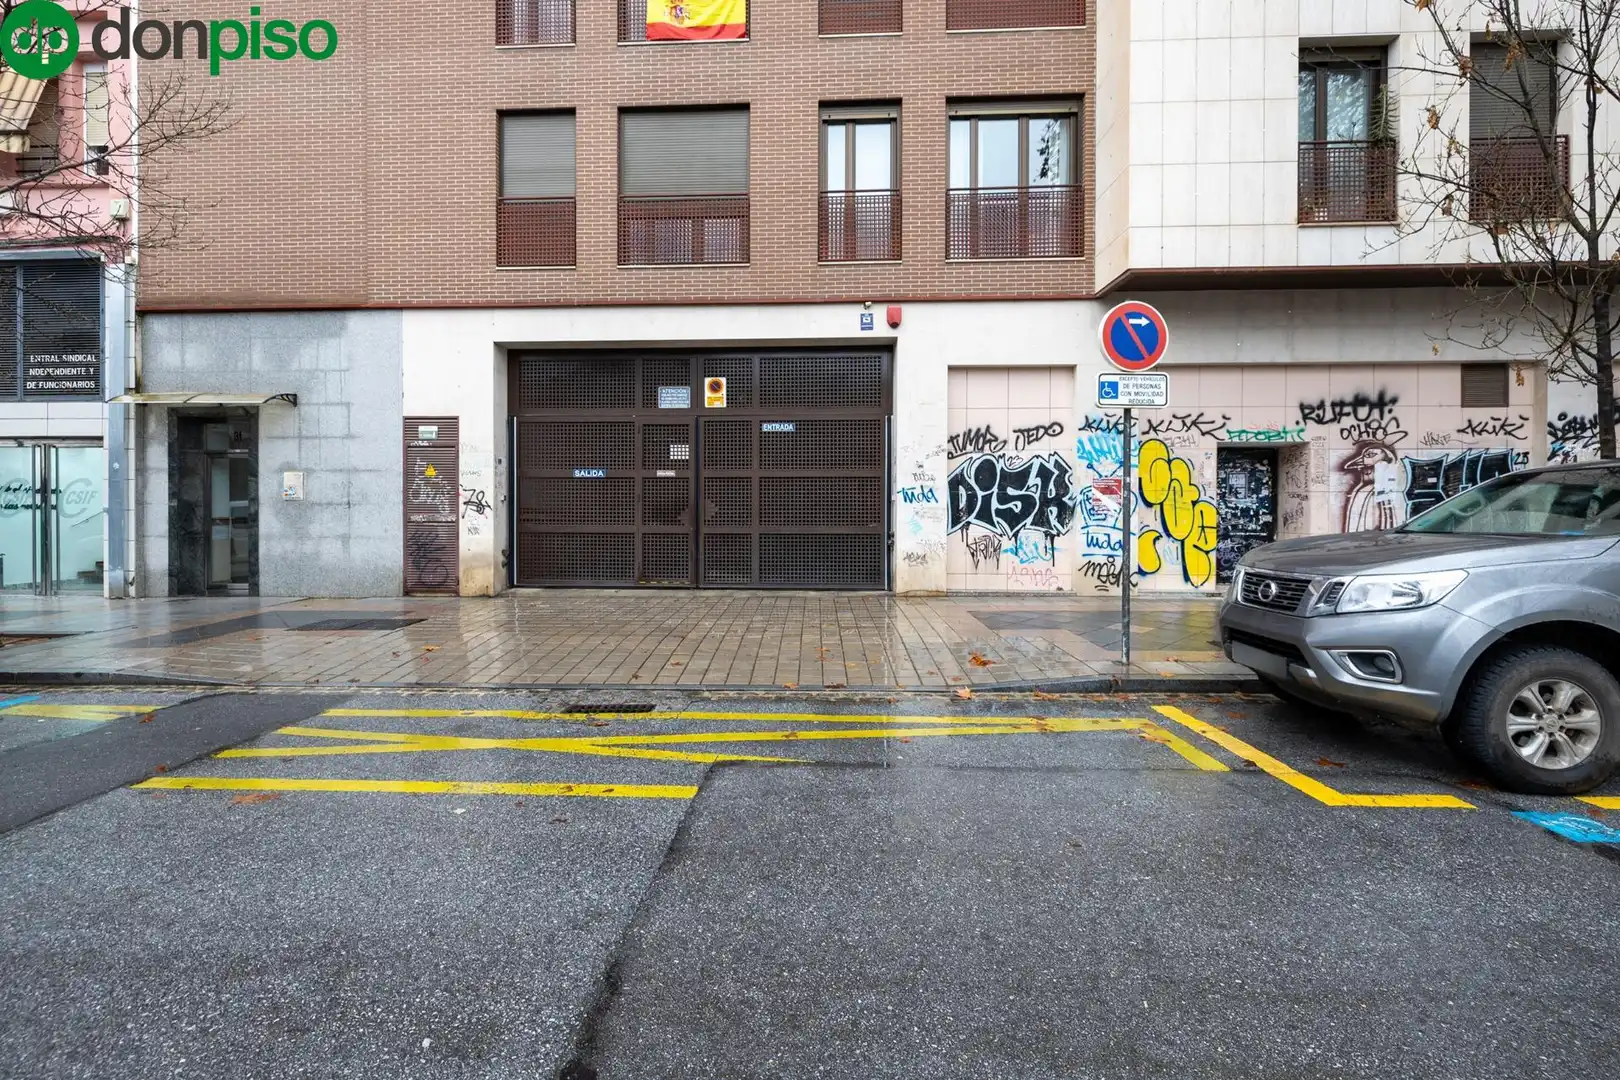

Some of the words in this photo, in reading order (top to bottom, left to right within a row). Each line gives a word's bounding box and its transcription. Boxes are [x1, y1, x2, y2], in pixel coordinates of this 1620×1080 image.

[62, 353, 96, 362] SINDICAL
[89, 367, 94, 375] Y
[26, 381, 37, 389] DE
[38, 380, 95, 389] FUNCIONARIOS
[65, 490, 98, 505] CSIF
